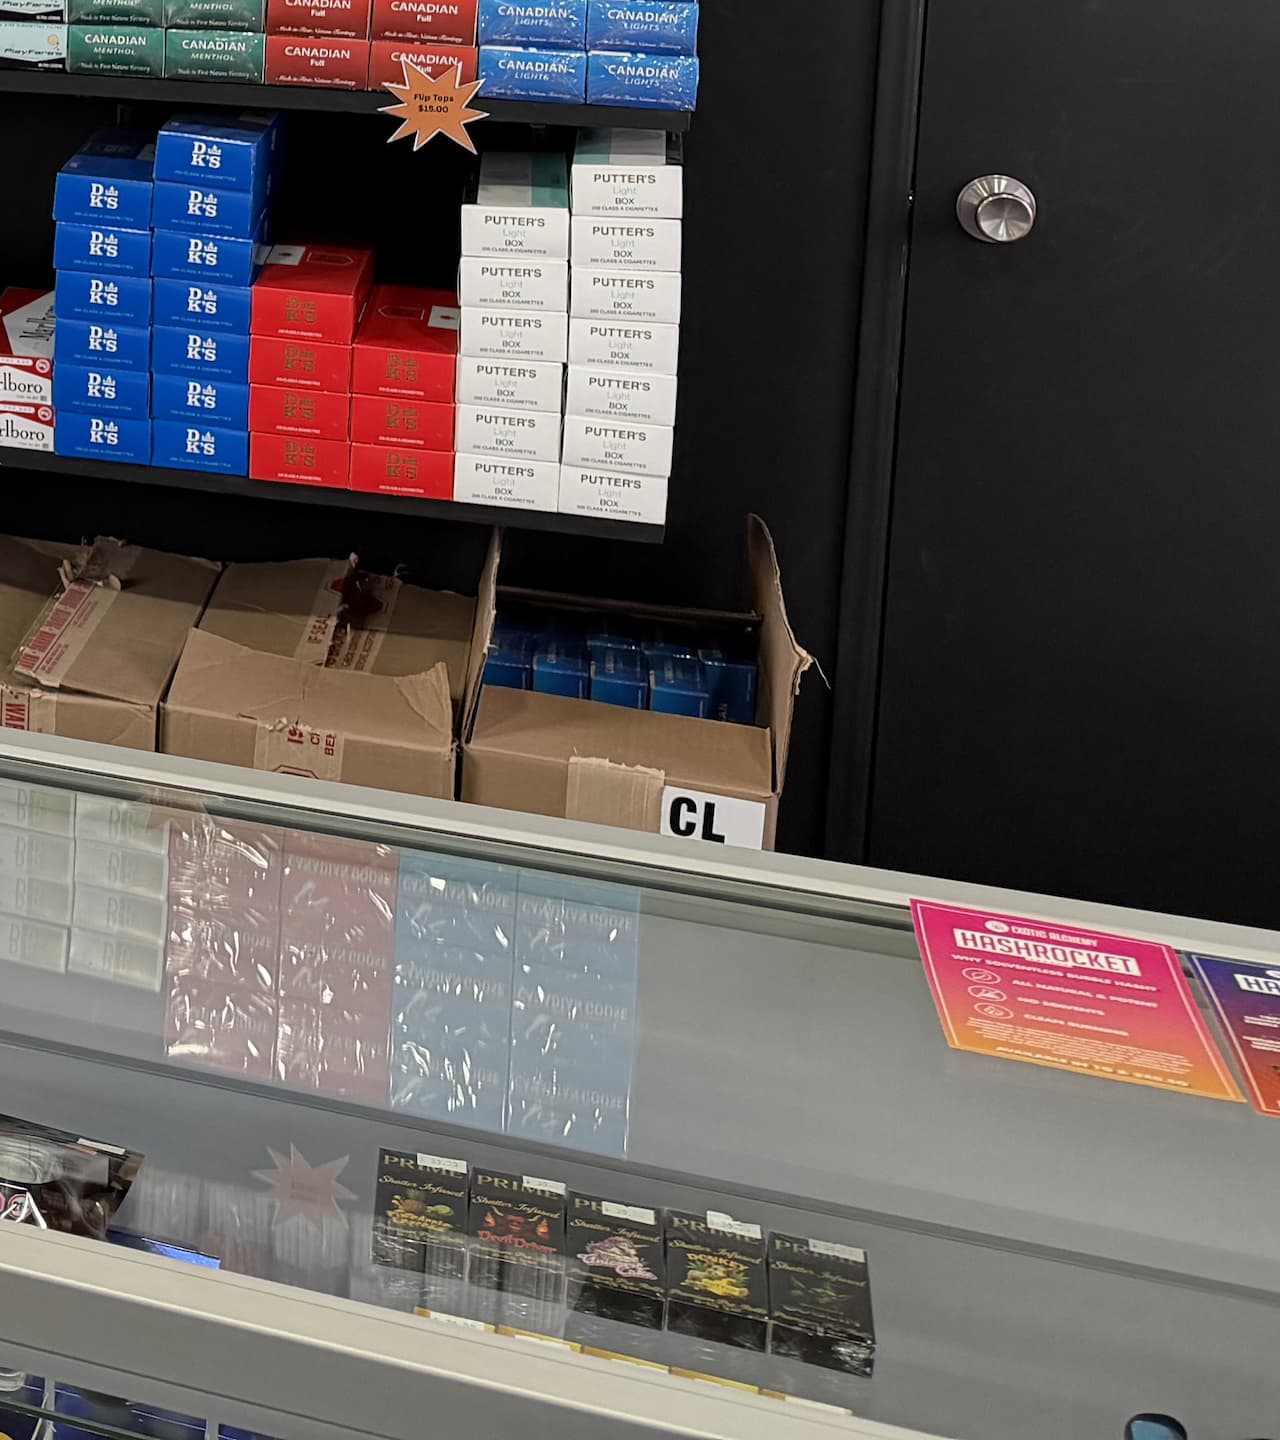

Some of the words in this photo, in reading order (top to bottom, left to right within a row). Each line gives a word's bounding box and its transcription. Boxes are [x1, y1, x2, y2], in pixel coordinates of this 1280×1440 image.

[414, 93, 430, 101] Flip
[433, 94, 454, 102] Tops
[594, 174, 656, 185] PUTTER'S
[613, 185, 637, 196] Light
[615, 197, 634, 205] BOX
[484, 215, 545, 228] PUTTER'S
[503, 228, 526, 238] Light
[505, 239, 523, 247] BOX
[670, 797, 725, 844] CL
[962, 931, 1131, 973] HASHROCKET
[1013, 979, 1033, 988] ALL
[1036, 983, 1093, 998] NATURAL
